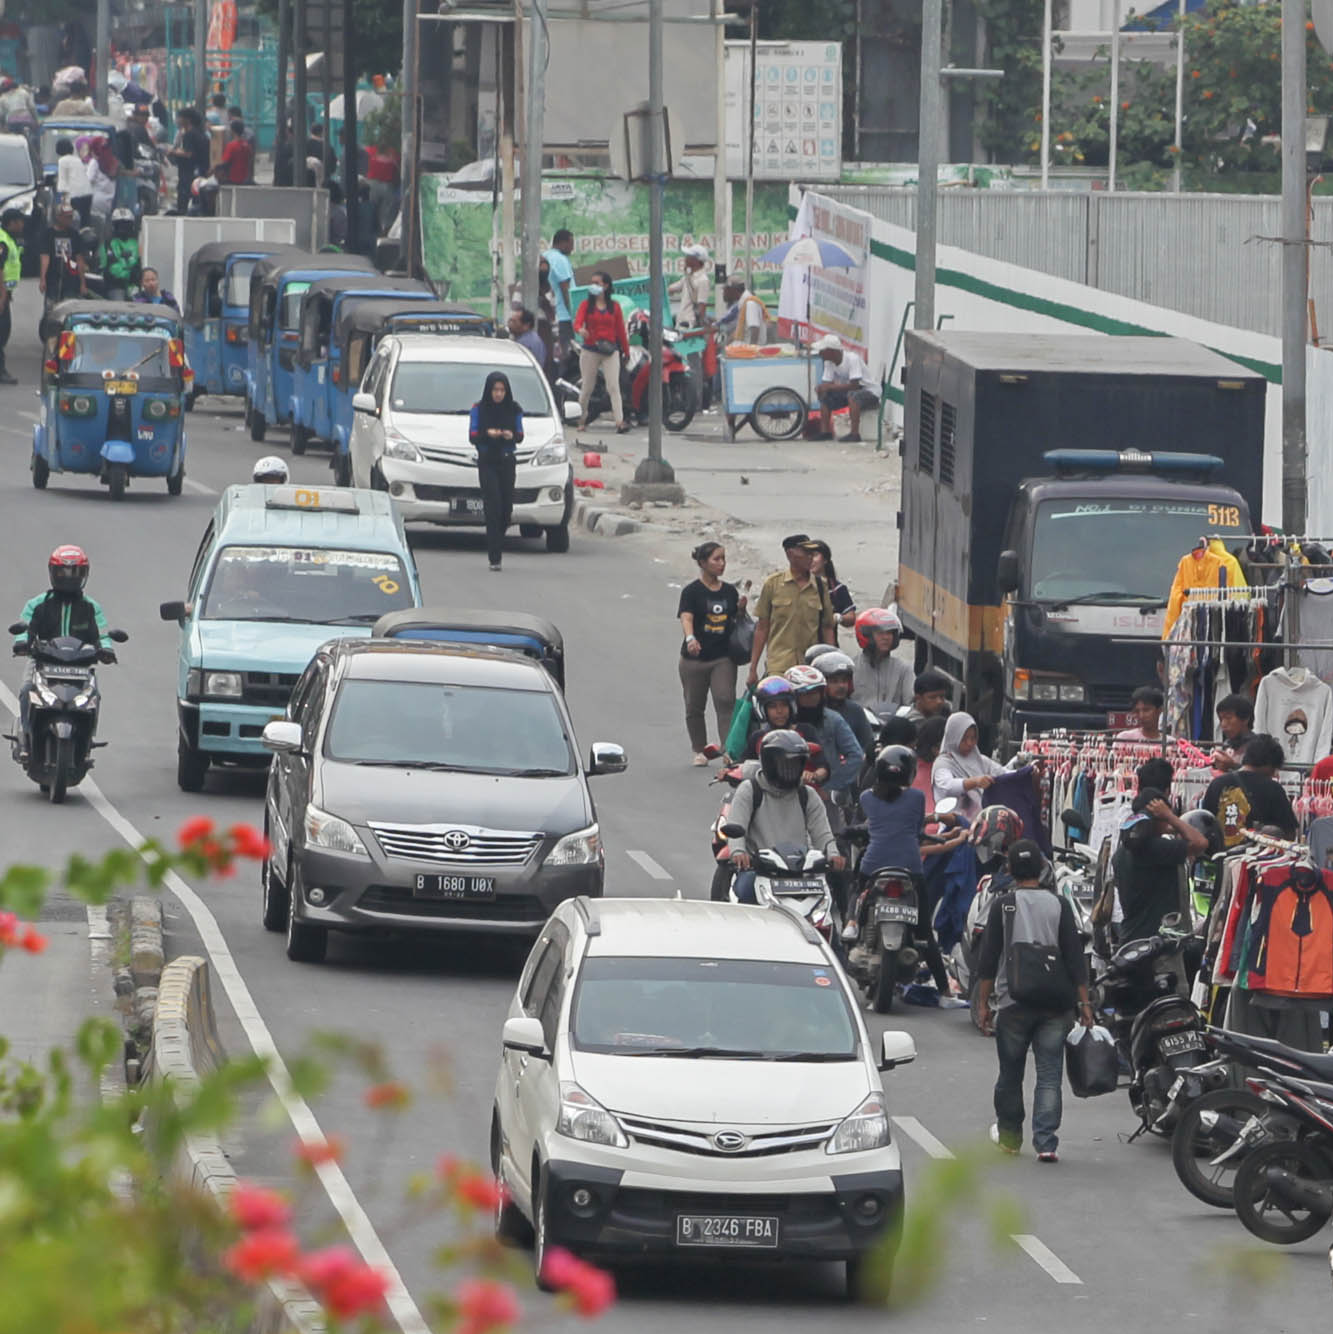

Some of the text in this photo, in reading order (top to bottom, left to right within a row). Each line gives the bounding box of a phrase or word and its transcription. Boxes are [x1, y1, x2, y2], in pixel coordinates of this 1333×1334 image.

[581, 235, 678, 251] PROSEDR
[702, 234, 768, 250] ATRAN
[1208, 504, 1240, 526] 5113
[1113, 615, 1163, 627] ISUZ
[417, 875, 425, 889] B
[438, 876, 465, 891] 1680
[683, 1219, 772, 1237] B 2346 FBA
